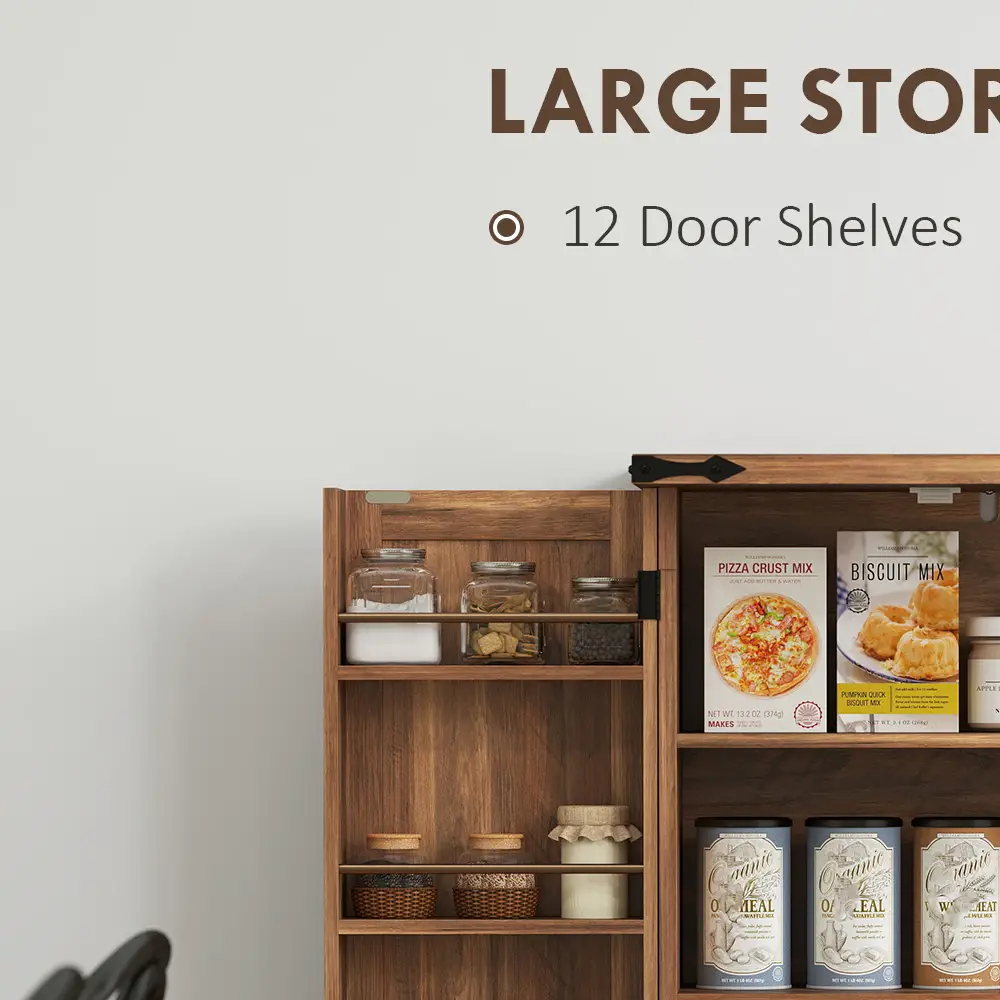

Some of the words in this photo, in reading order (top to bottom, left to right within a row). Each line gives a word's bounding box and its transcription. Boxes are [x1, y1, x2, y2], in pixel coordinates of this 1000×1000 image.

[718, 563, 749, 574] PIZZA
[752, 563, 789, 574] CRUST
[792, 563, 813, 574] MIX
[851, 563, 910, 580] BISCUIT
[919, 563, 944, 580] MIX
